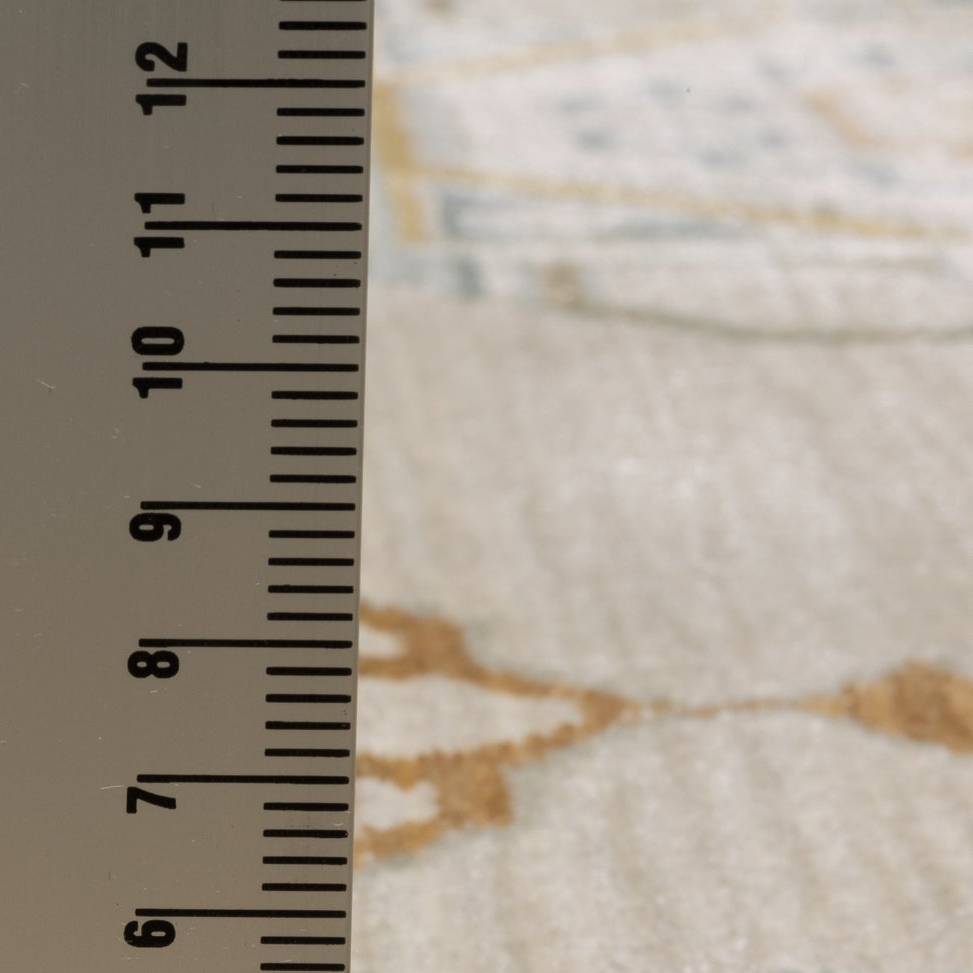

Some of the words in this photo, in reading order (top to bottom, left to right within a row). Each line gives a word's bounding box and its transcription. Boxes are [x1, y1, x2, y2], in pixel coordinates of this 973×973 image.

[134, 41, 189, 117] 12
[132, 192, 186, 259] 11
[130, 325, 186, 400] 10
[128, 511, 182, 543] 9
[126, 649, 180, 680] 8
[125, 786, 177, 815] 7
[123, 919, 177, 949] 6
